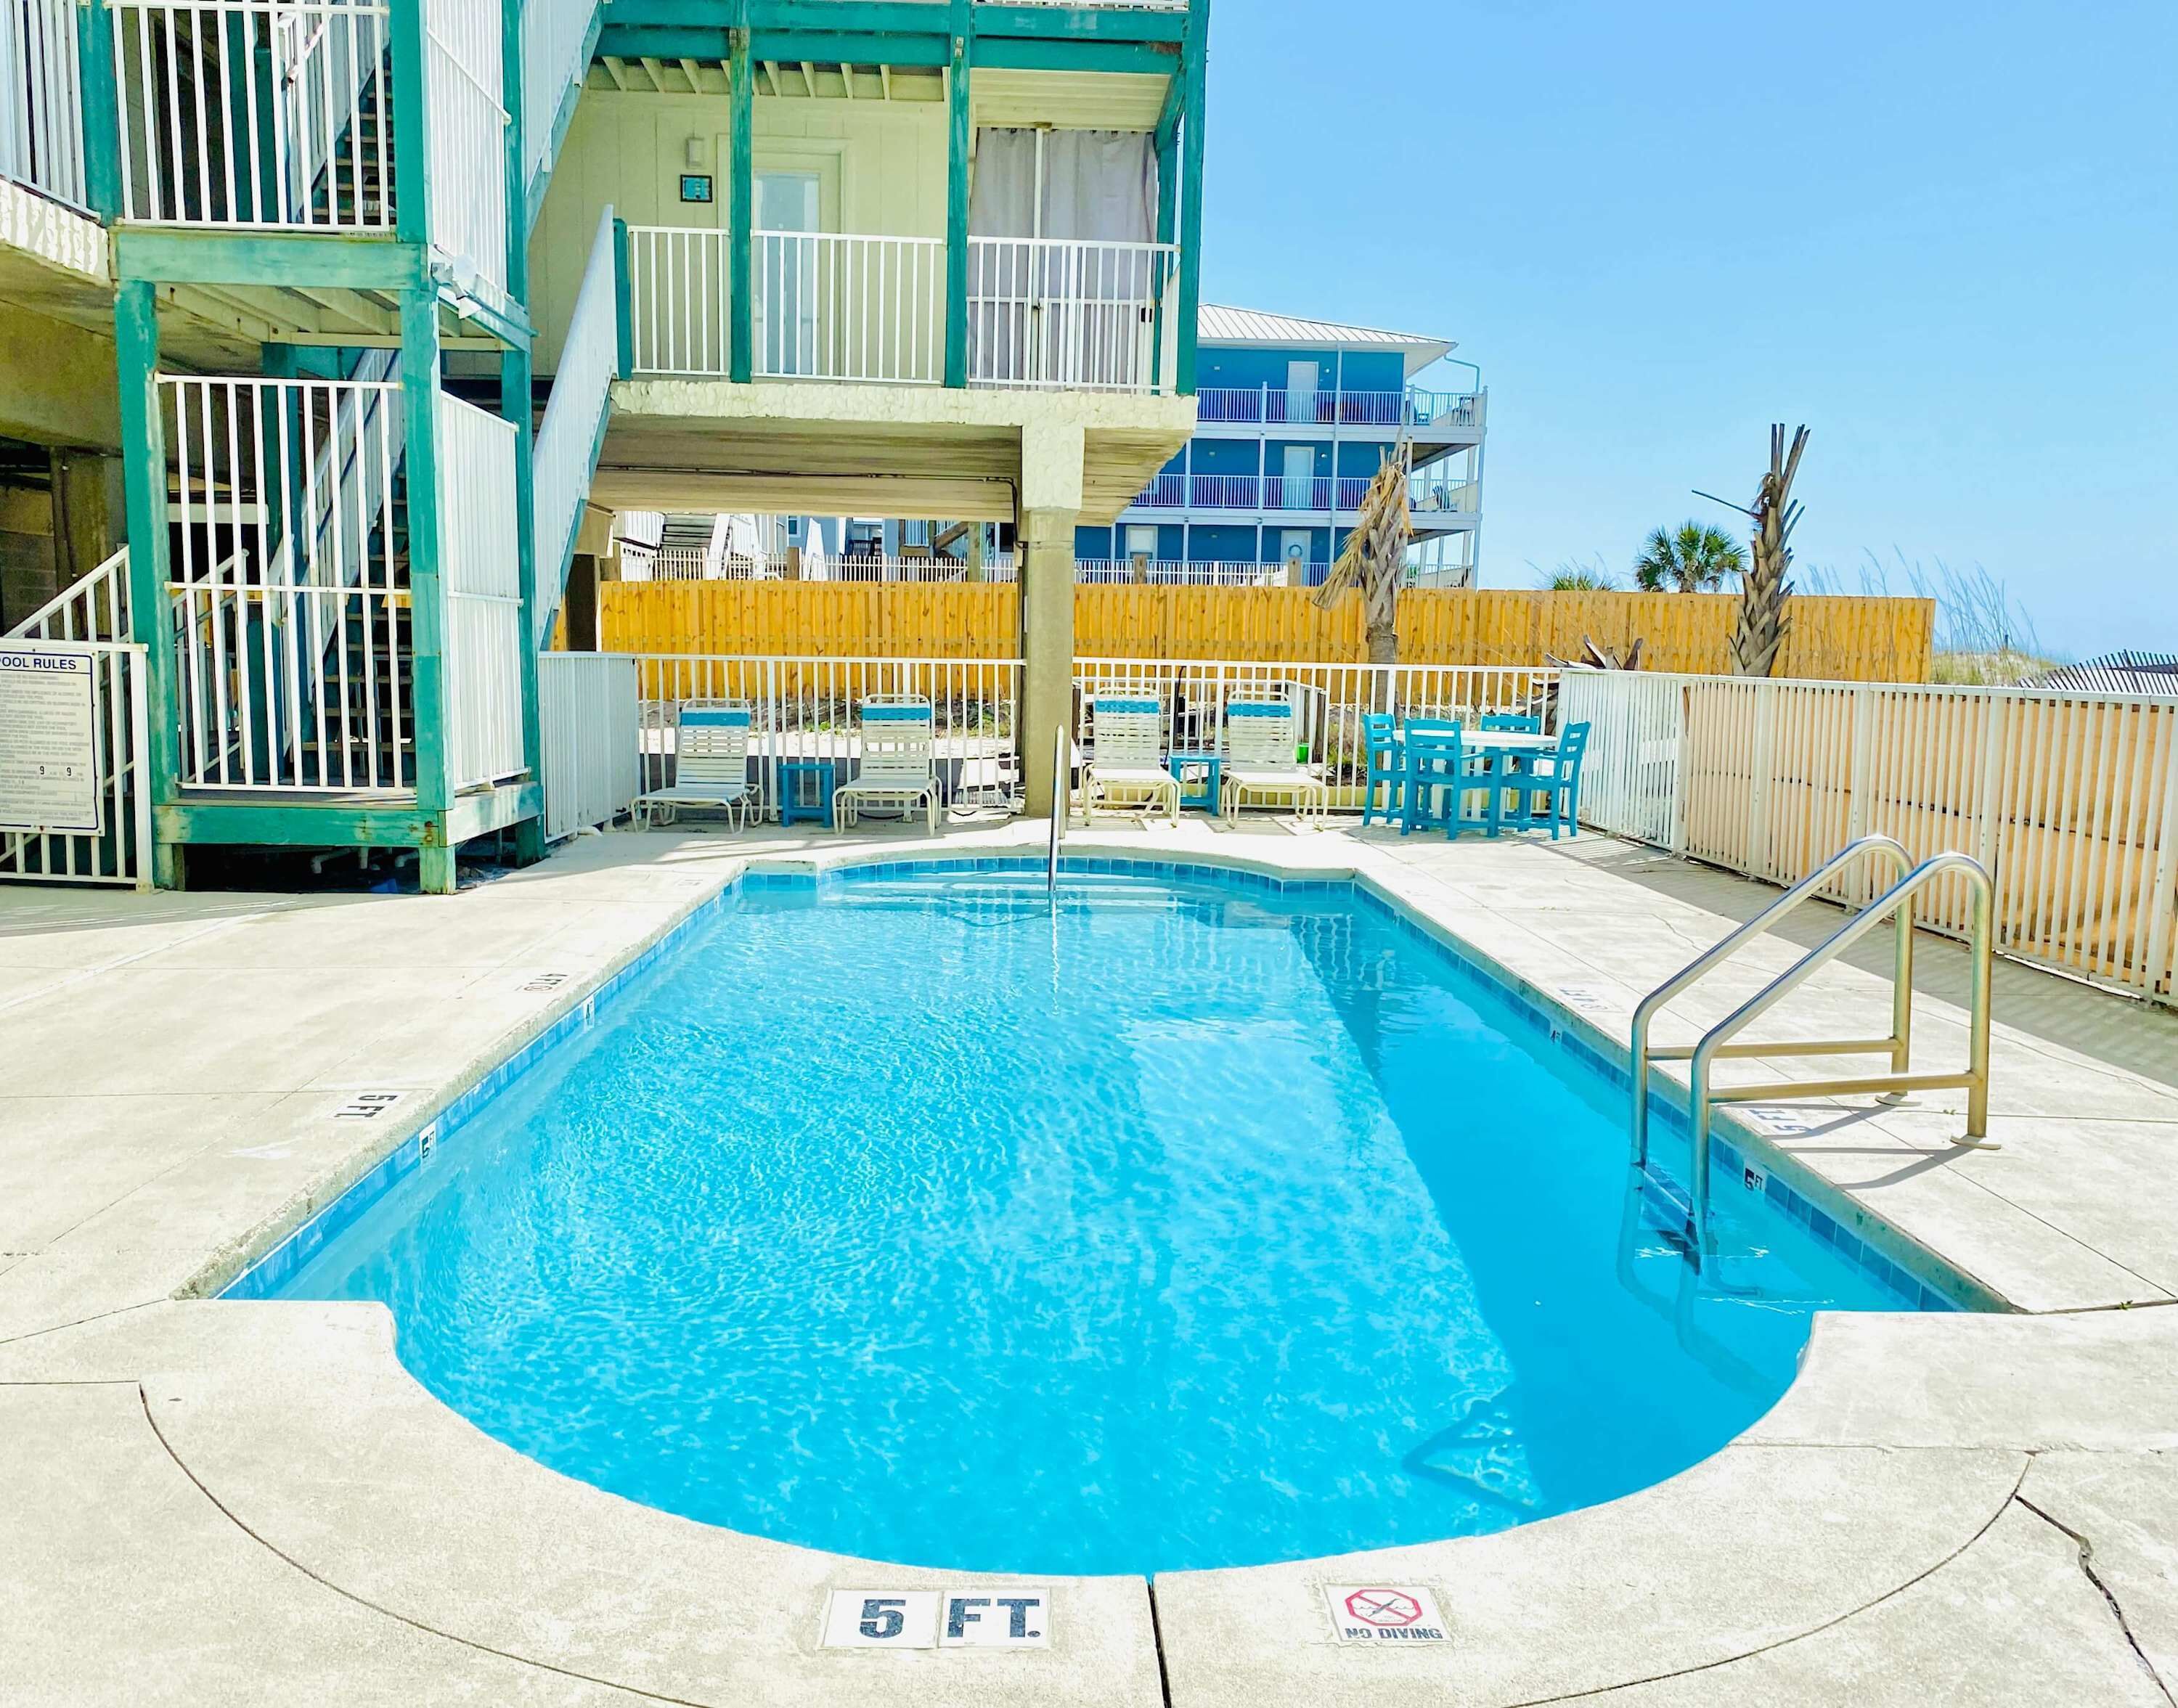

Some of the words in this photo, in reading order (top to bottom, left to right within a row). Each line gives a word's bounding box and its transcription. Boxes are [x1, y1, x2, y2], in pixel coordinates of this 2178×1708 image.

[0, 656, 29, 668] OOL
[33, 658, 76, 669] RULES
[40, 766, 44, 775] 9
[67, 767, 71, 776] 9
[422, 1136, 430, 1159] 5
[1745, 1168, 1755, 1191] 5
[859, 1599, 906, 1638] 5
[947, 1598, 1041, 1638] FT.
[1345, 1627, 1372, 1639] NO
[1377, 1627, 1443, 1639] DIVING
